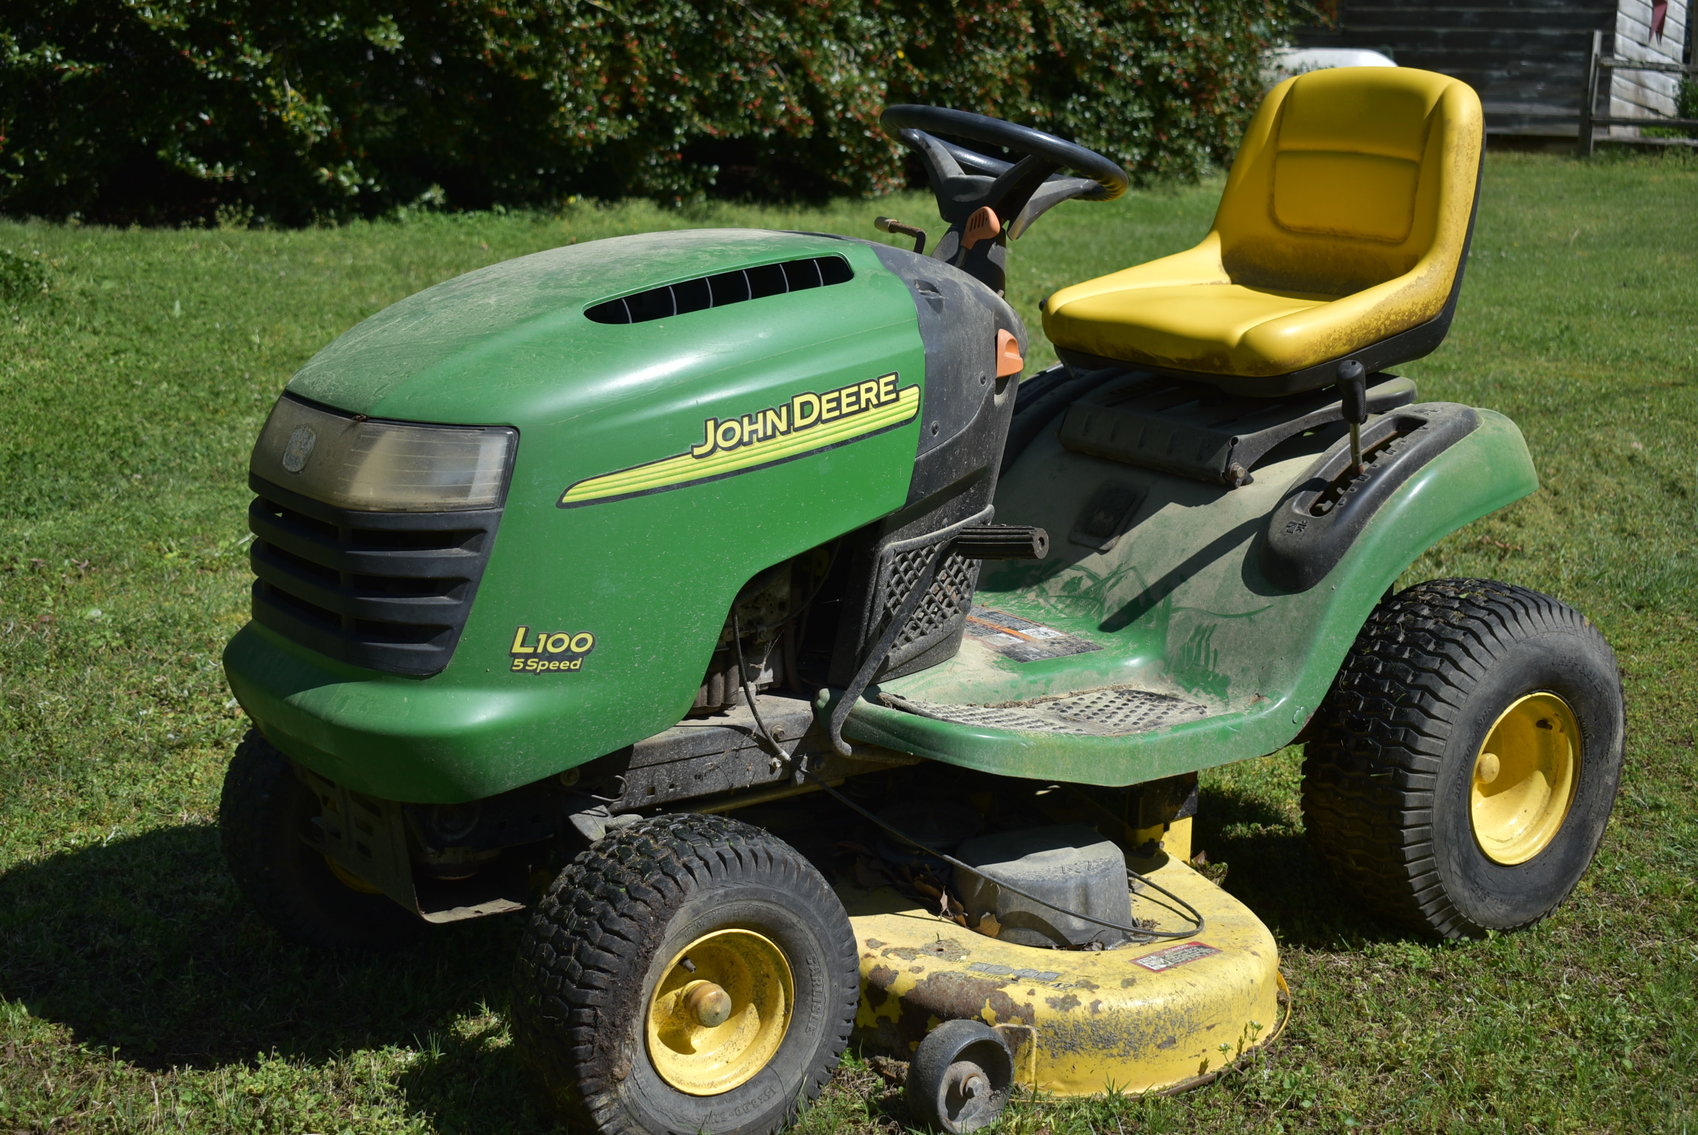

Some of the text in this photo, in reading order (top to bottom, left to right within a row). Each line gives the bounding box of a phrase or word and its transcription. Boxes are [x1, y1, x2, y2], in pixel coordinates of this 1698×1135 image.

[691, 373, 898, 458] JOHN DEERE
[510, 626, 594, 654] L100
[511, 657, 583, 673] 5 Speed
